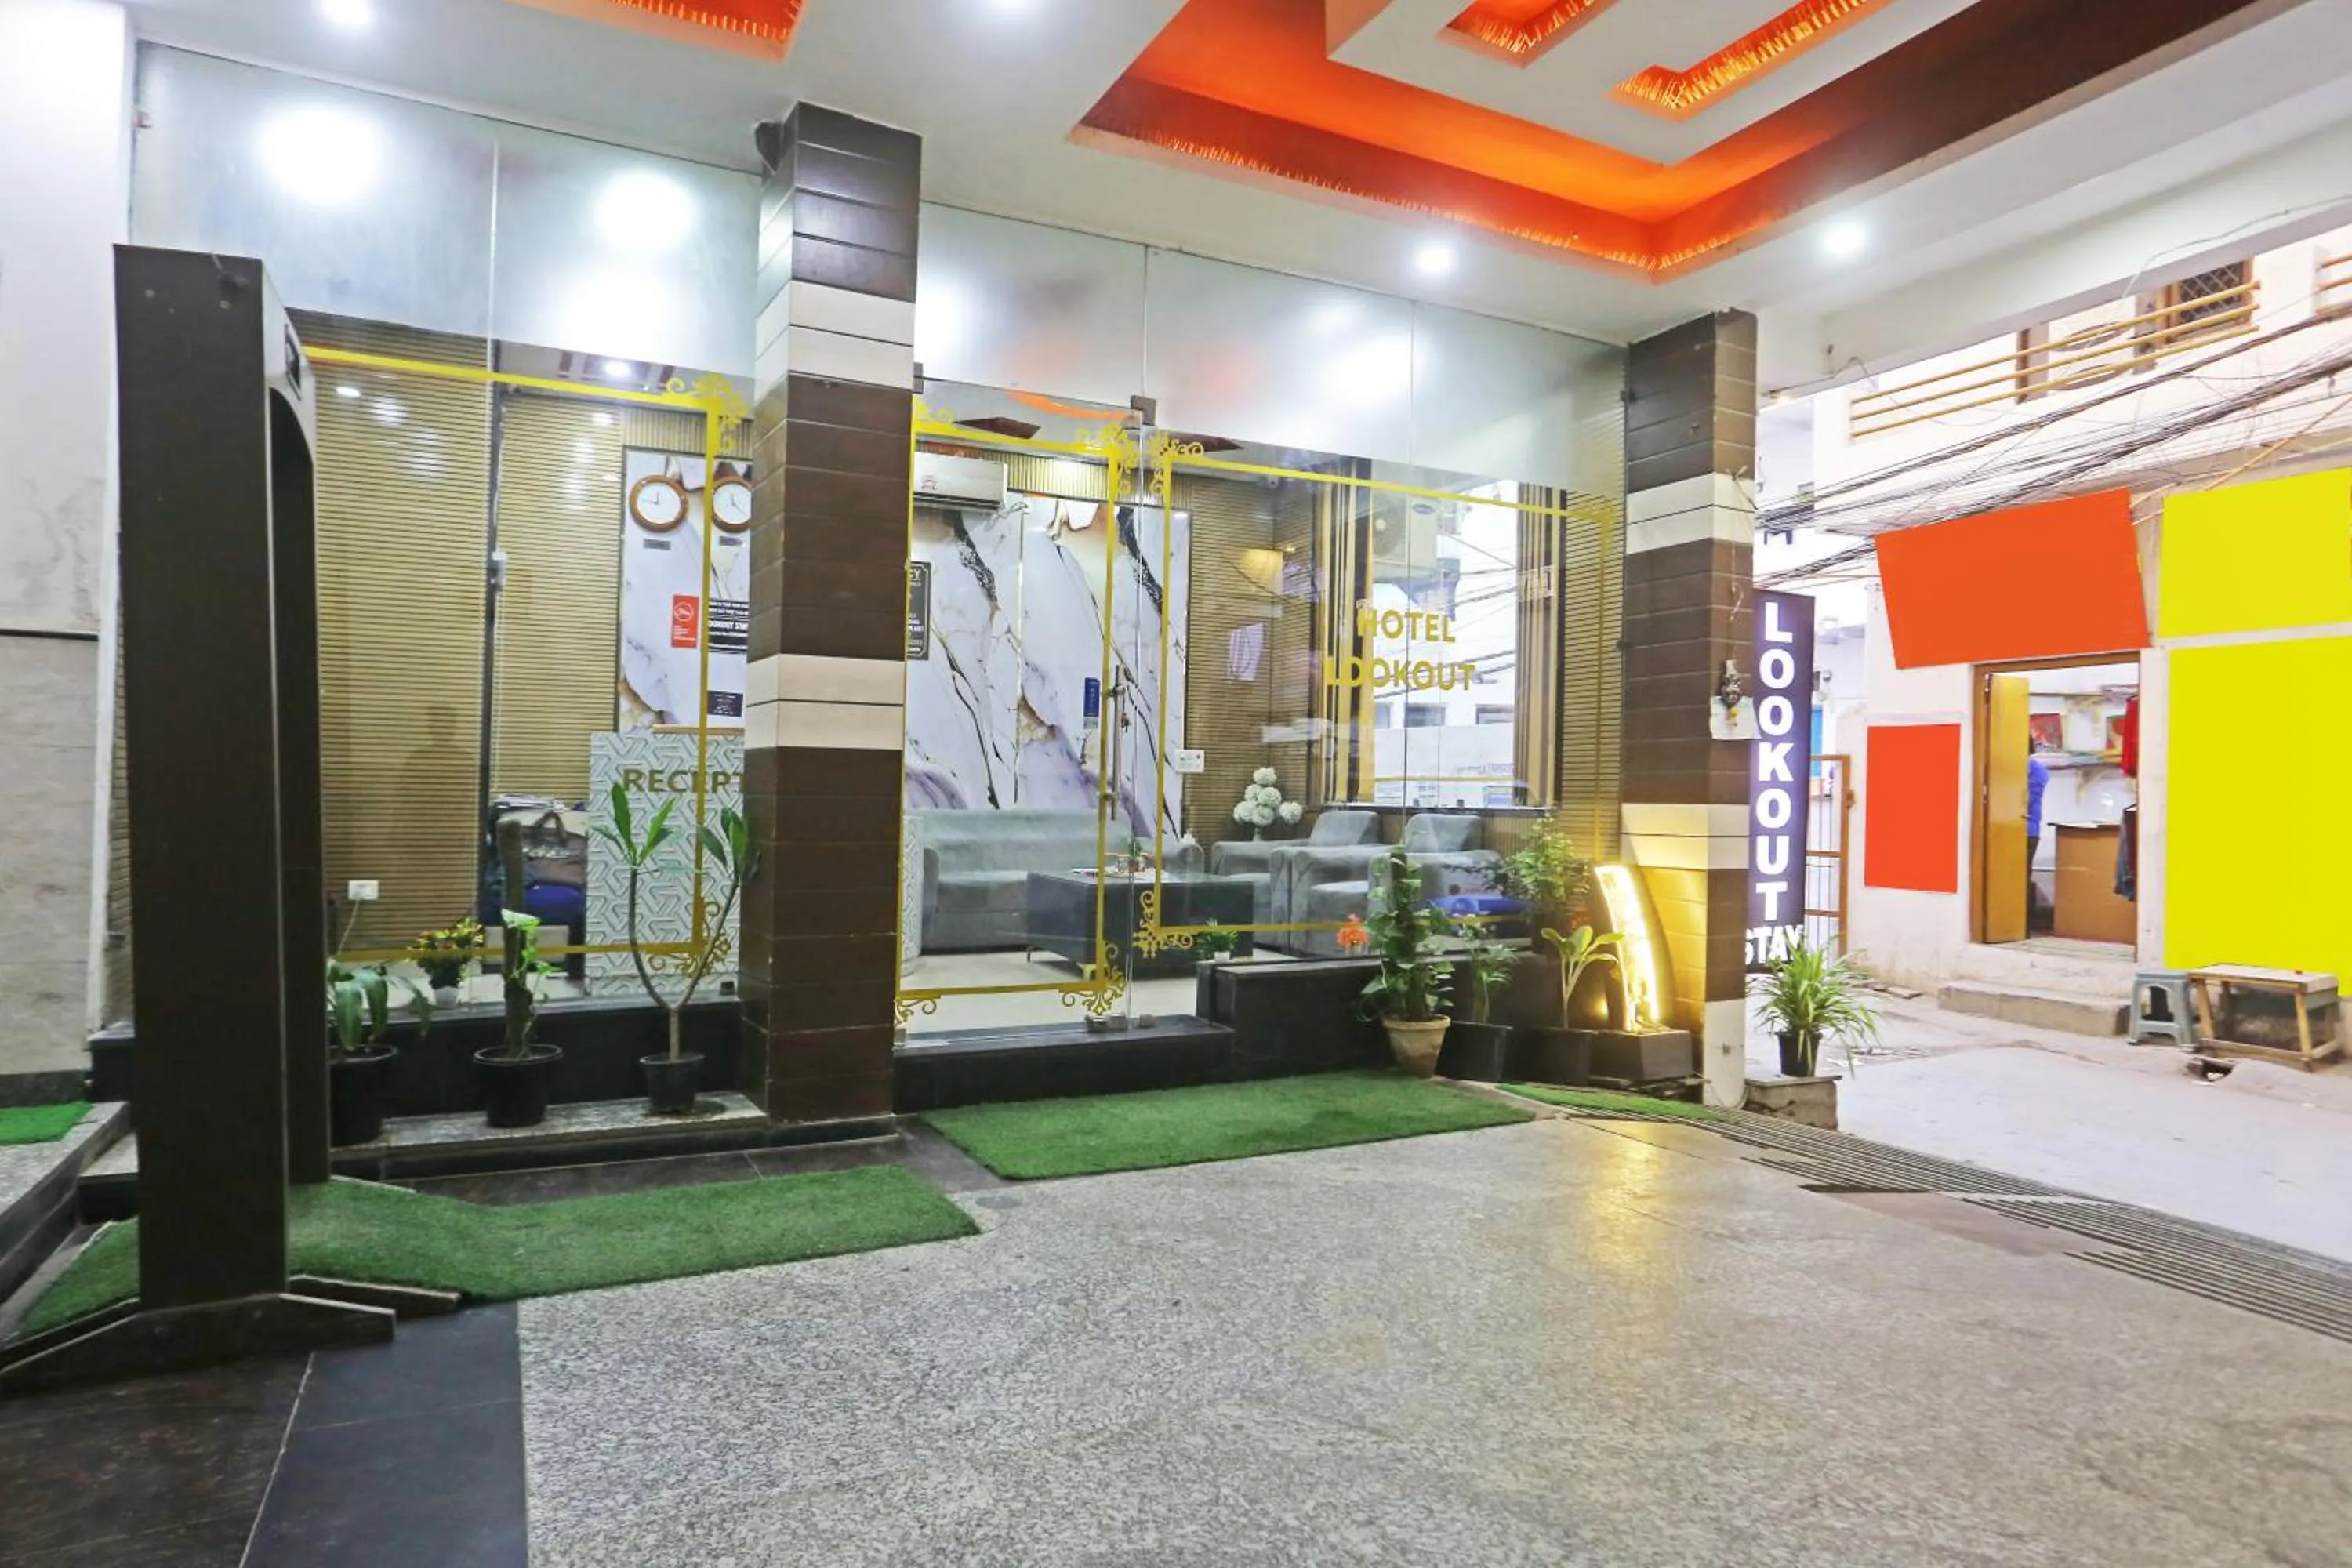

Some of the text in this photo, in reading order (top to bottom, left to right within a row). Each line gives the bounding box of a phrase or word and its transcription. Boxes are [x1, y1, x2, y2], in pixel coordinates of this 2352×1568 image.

[1357, 609, 1456, 643] HOTEL
[1324, 655, 1475, 691] LOOKOUT
[1755, 601, 1795, 921] LOOKOUT
